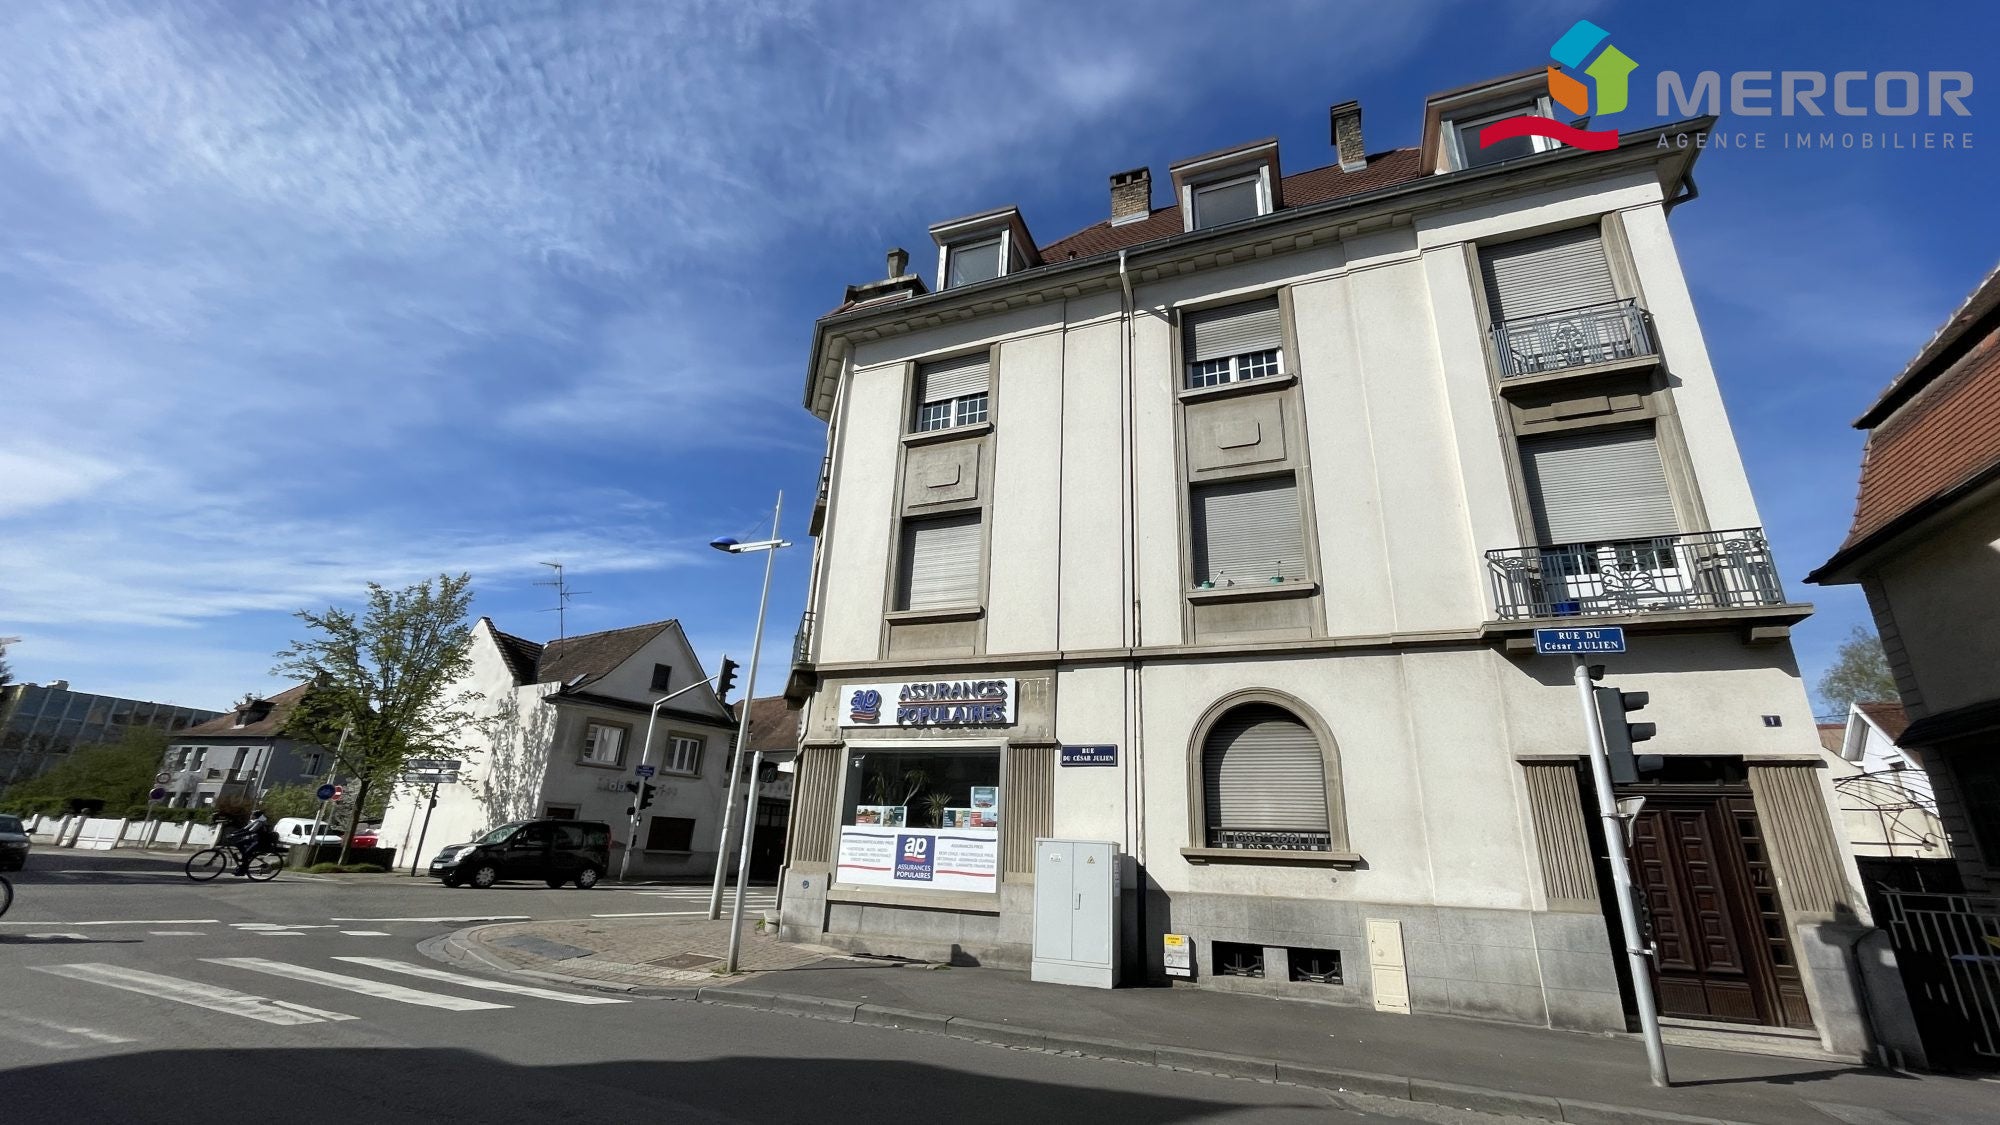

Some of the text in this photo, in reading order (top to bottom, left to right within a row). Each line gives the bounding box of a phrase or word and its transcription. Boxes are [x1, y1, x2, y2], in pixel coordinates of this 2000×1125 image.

[1558, 631, 1601, 640] RUE DU
[1544, 641, 1619, 650] César JULIEN
[899, 680, 1007, 700] ASSURANCES
[850, 689, 879, 713] ap
[896, 703, 1006, 724] POPULAIRES
[1770, 716, 1775, 725] 1
[904, 837, 927, 858] ap
[897, 863, 931, 872] ASSURANCES
[896, 871, 931, 879] POPULAIRES
